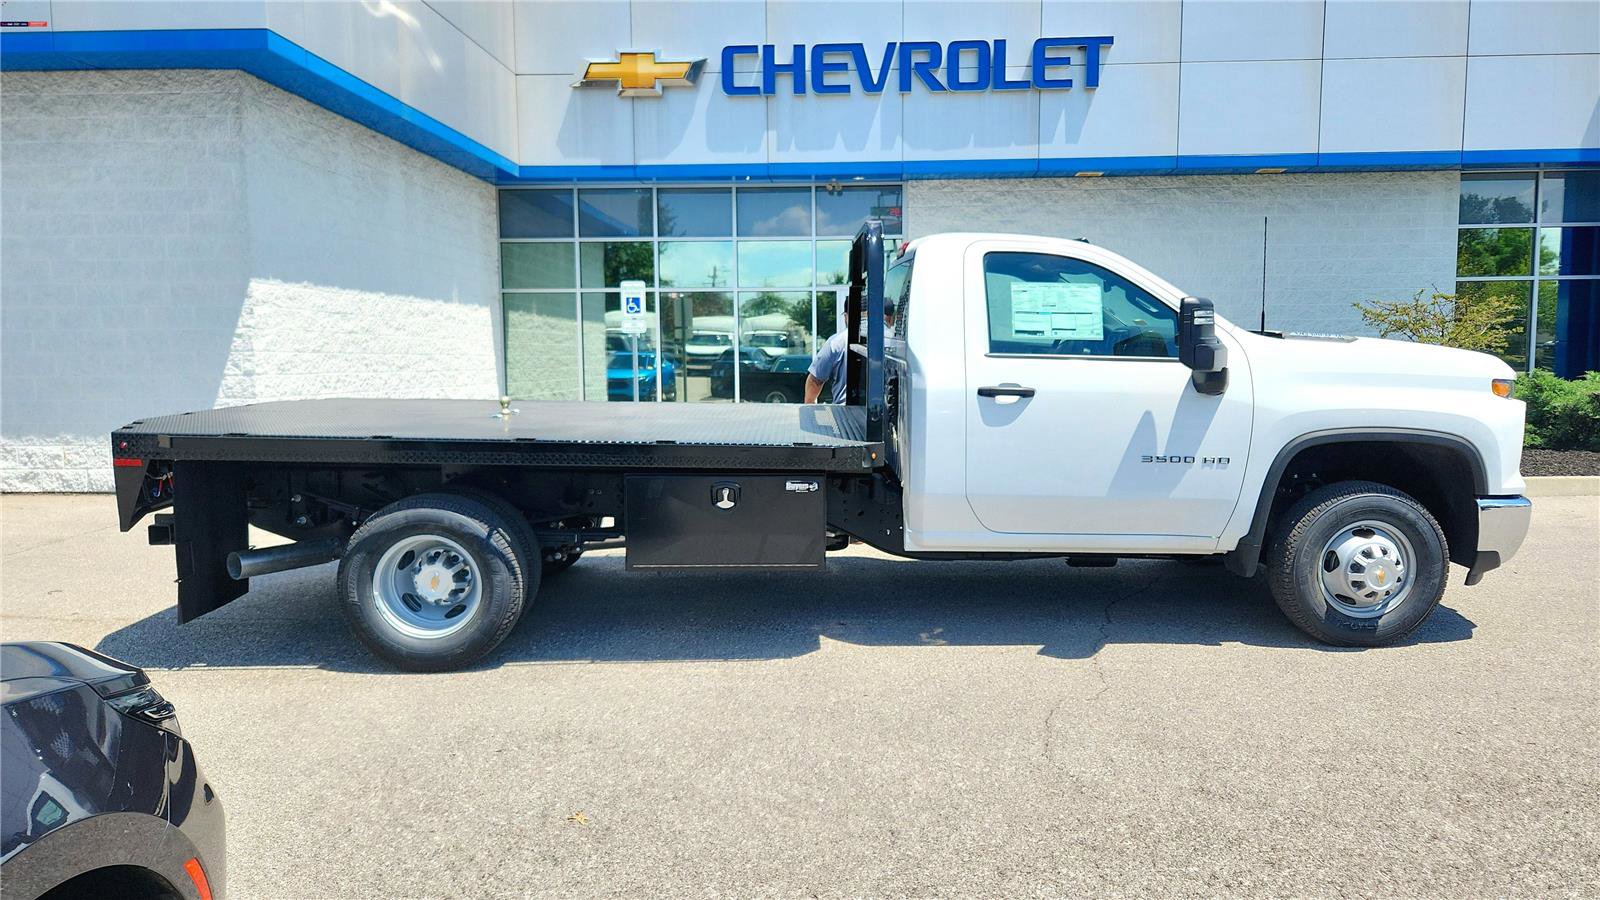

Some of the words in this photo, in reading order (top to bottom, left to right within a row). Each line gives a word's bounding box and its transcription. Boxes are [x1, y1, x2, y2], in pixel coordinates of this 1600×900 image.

[721, 36, 1114, 96] CHEVROLET
[1140, 455, 1196, 464] 3500
[1202, 456, 1231, 465] HD
